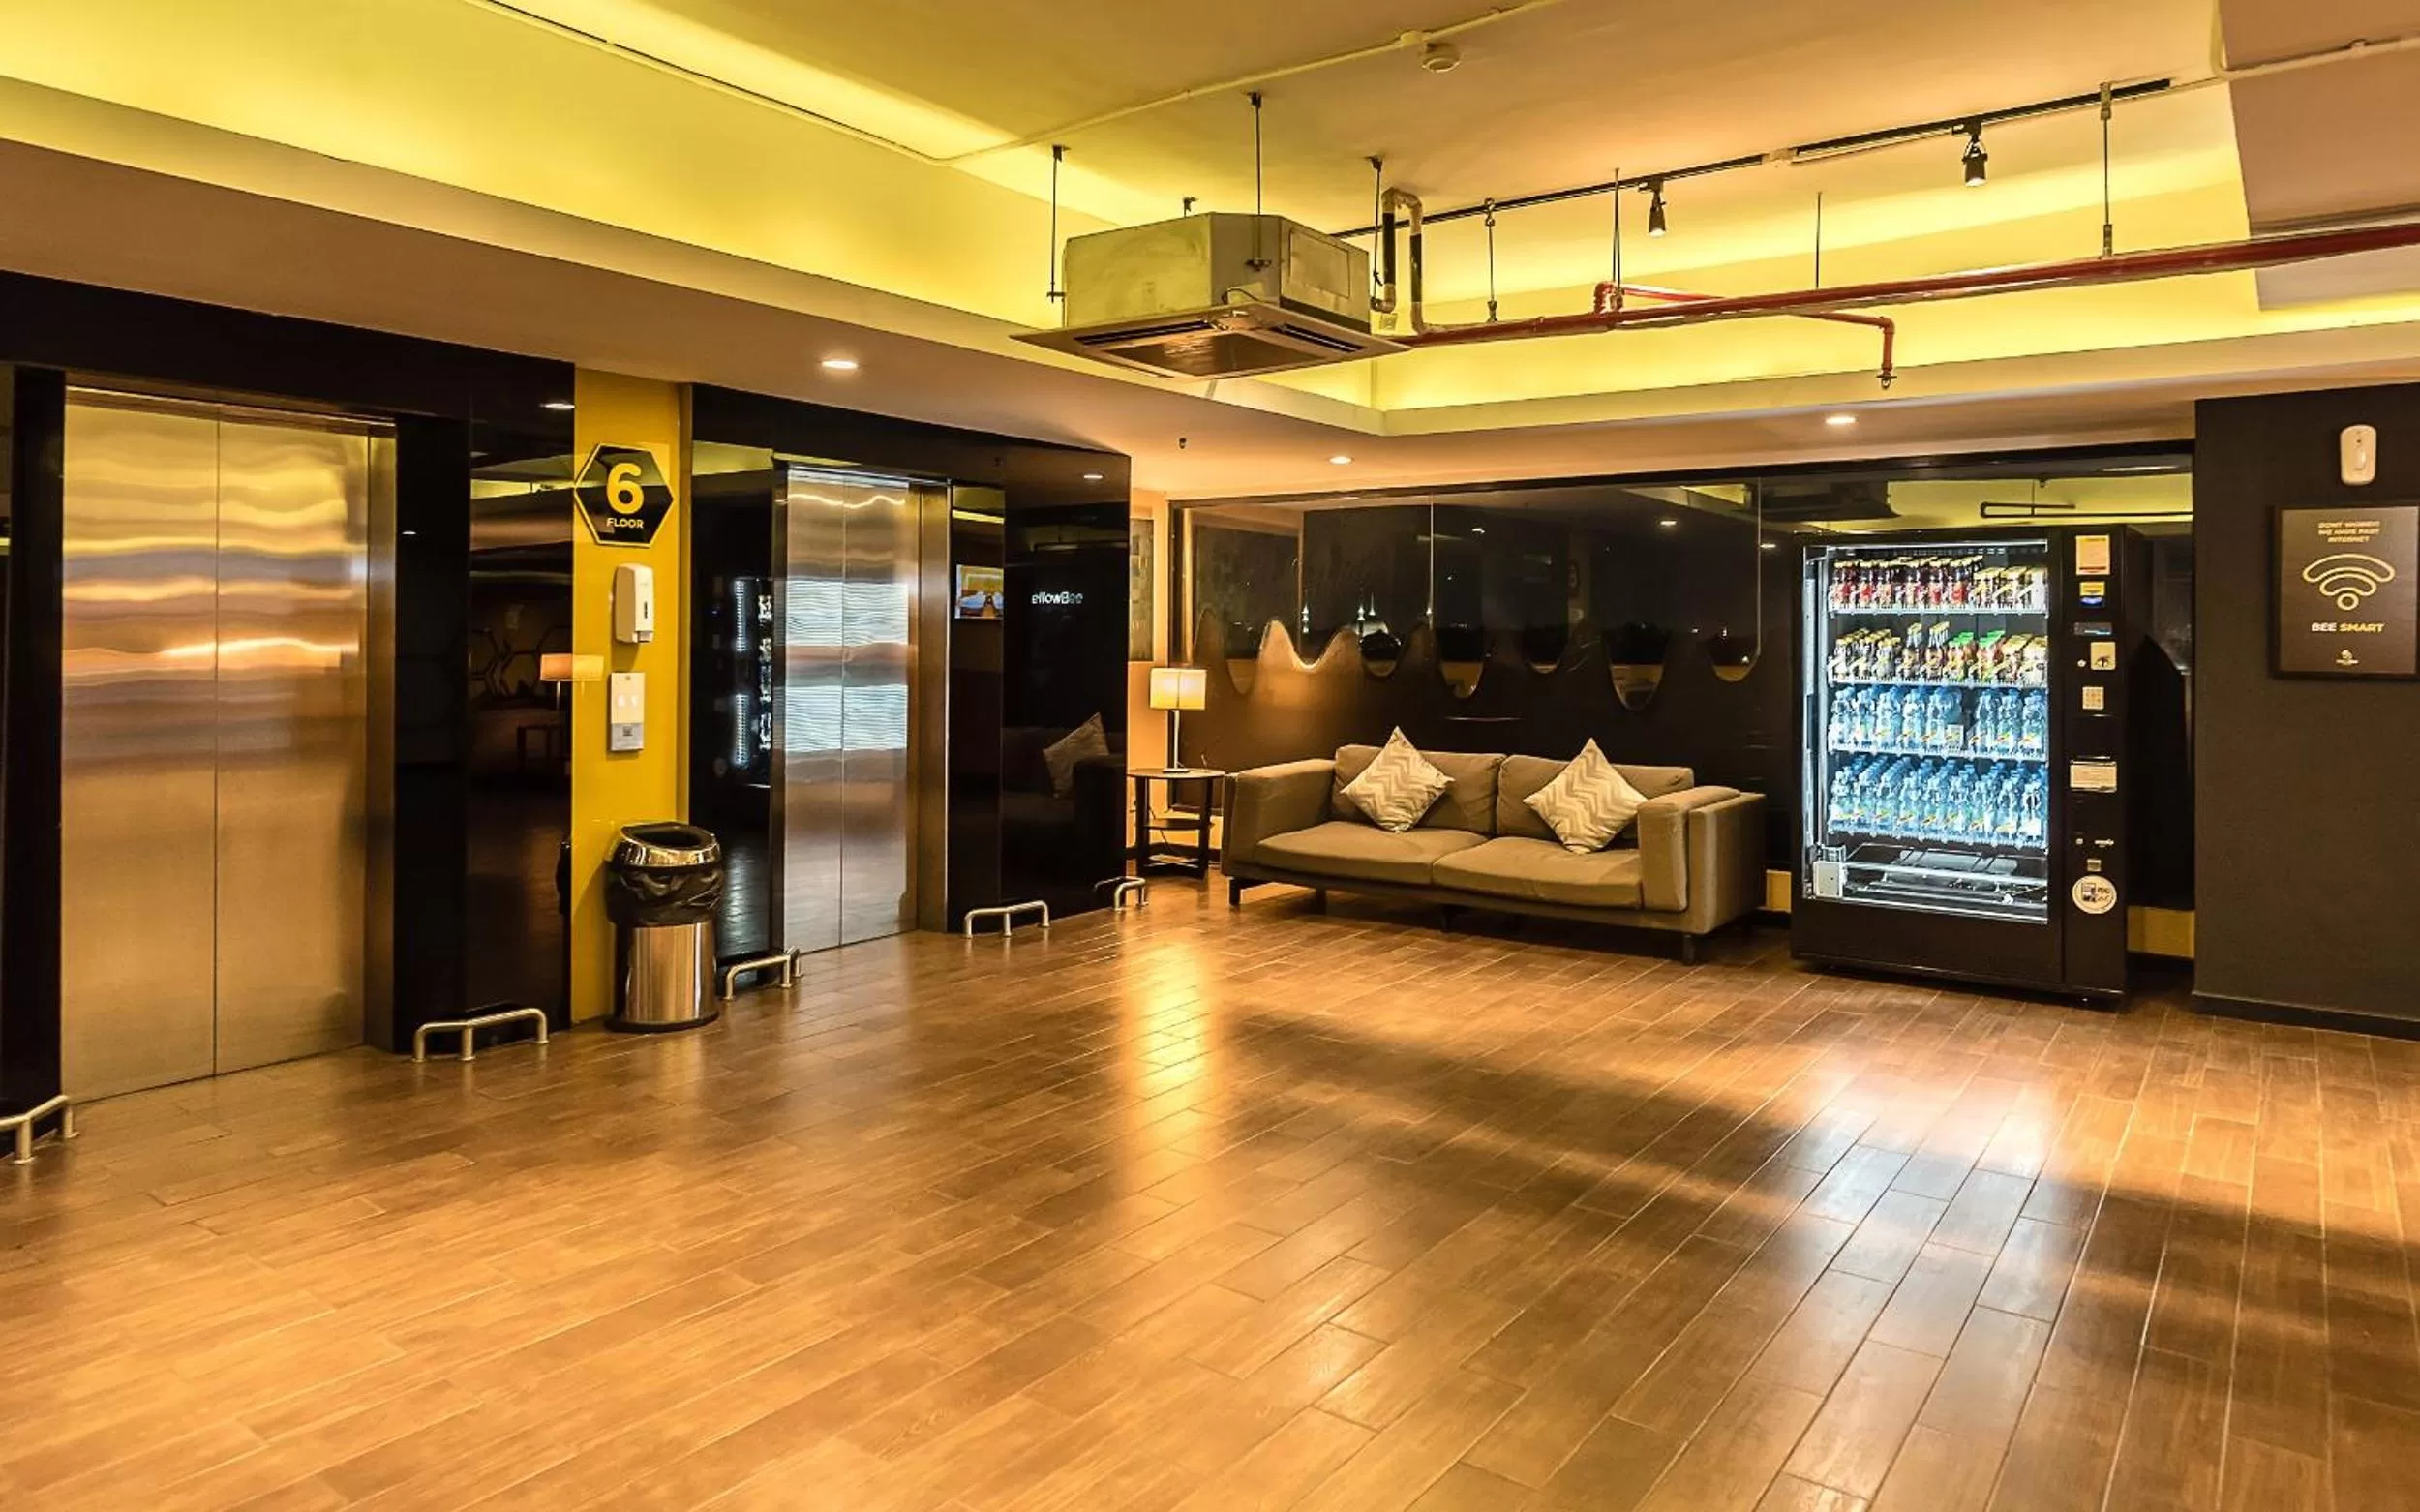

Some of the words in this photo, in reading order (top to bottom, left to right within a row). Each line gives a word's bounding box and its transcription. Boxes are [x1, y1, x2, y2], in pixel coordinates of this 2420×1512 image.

[607, 463, 644, 514] 6
[606, 518, 644, 529] FLOOR
[2311, 622, 2337, 632] BEE
[2339, 622, 2384, 633] SMART
